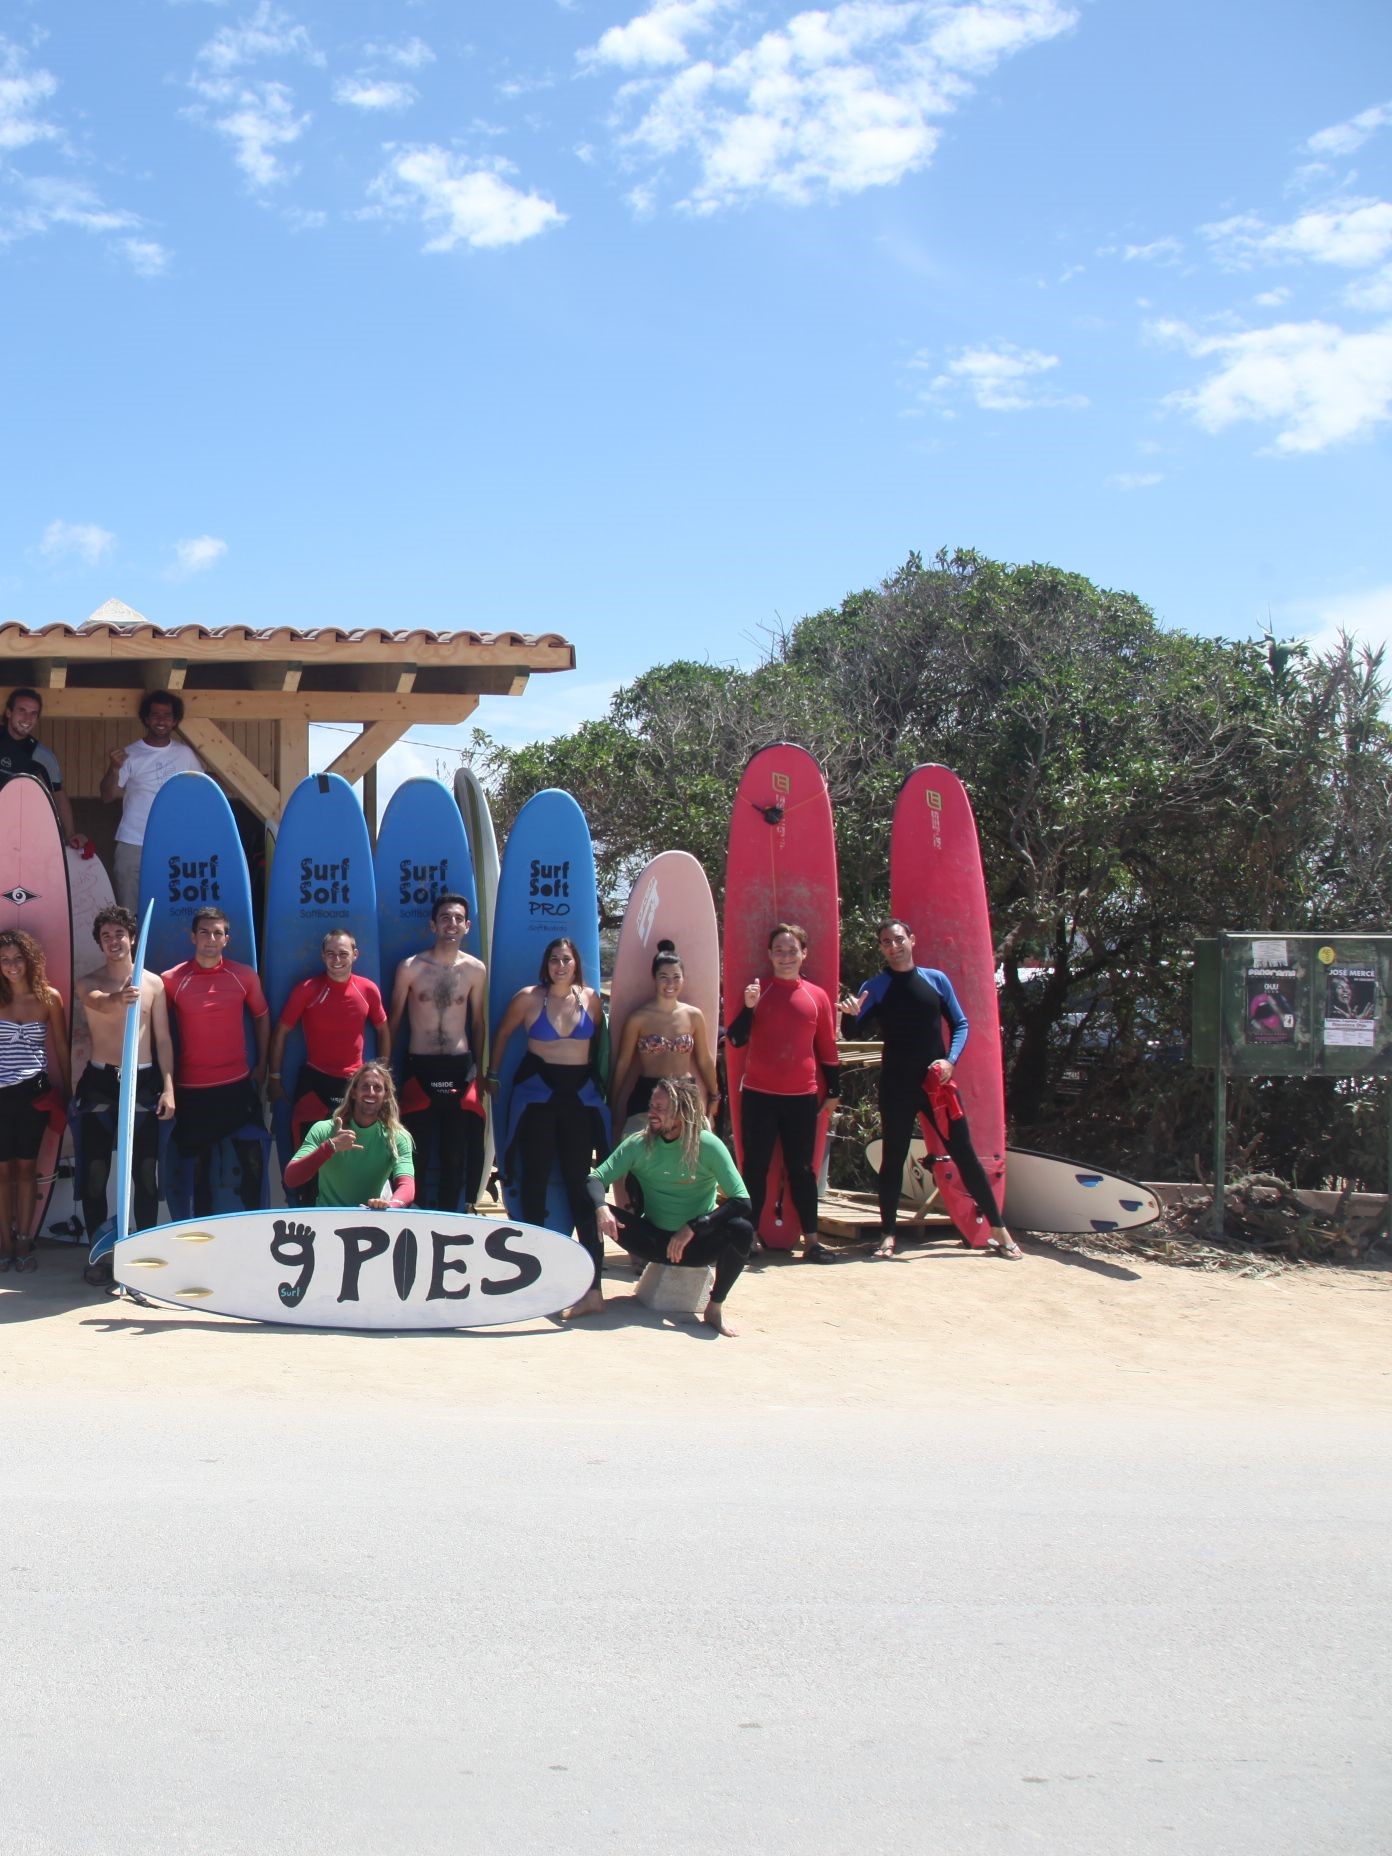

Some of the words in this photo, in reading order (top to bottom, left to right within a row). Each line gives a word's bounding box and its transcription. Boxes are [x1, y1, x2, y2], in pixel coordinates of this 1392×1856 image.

[168, 855, 219, 879] Surf
[300, 857, 350, 881] Surf
[399, 859, 449, 882] Surf
[530, 860, 570, 879] Surf
[168, 879, 221, 902] Soft
[300, 881, 350, 904] Soft
[529, 879, 570, 898] Soft
[528, 901, 570, 916] PRO
[280, 1286, 301, 1297] Surf
